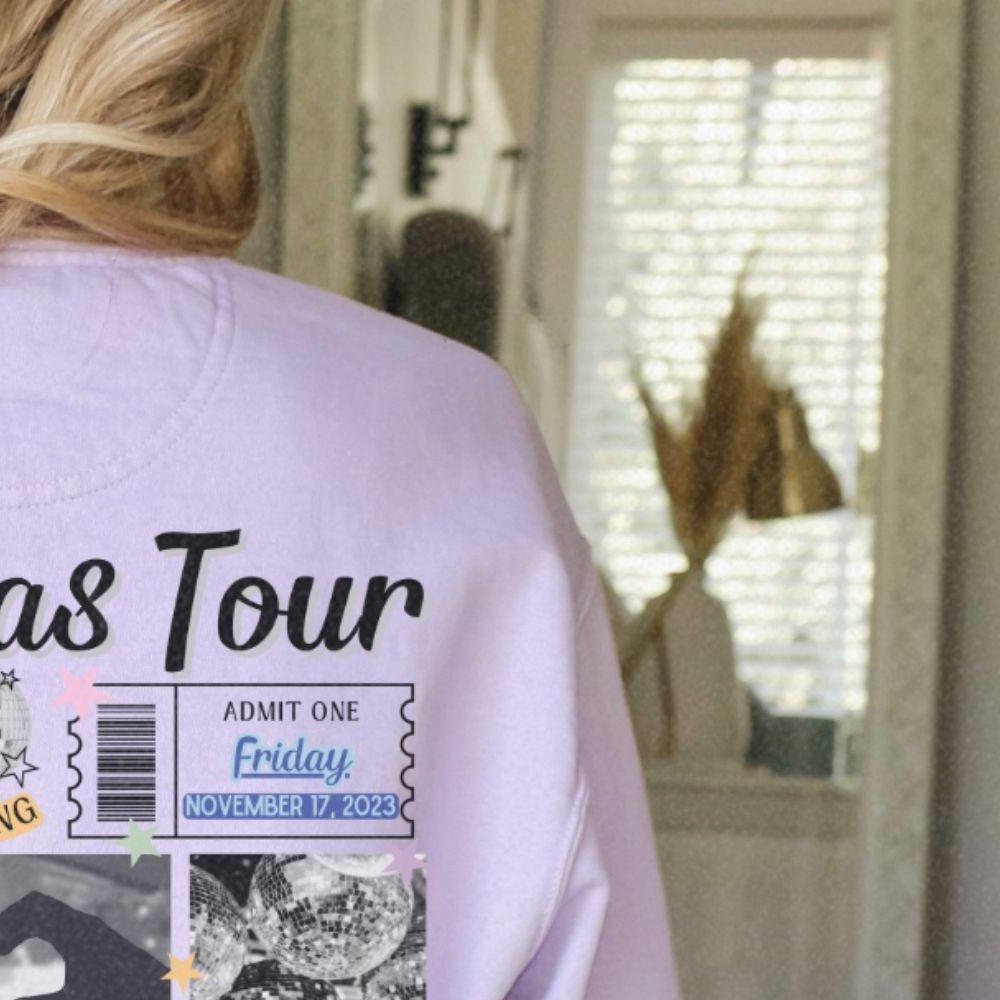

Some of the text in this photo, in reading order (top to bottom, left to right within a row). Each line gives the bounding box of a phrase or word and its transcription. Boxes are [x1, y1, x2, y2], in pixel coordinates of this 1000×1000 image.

[155, 528, 424, 672] Tour
[223, 701, 359, 721] ADMIT ONE
[185, 795, 396, 819] NOVEMBER 17, 2023
